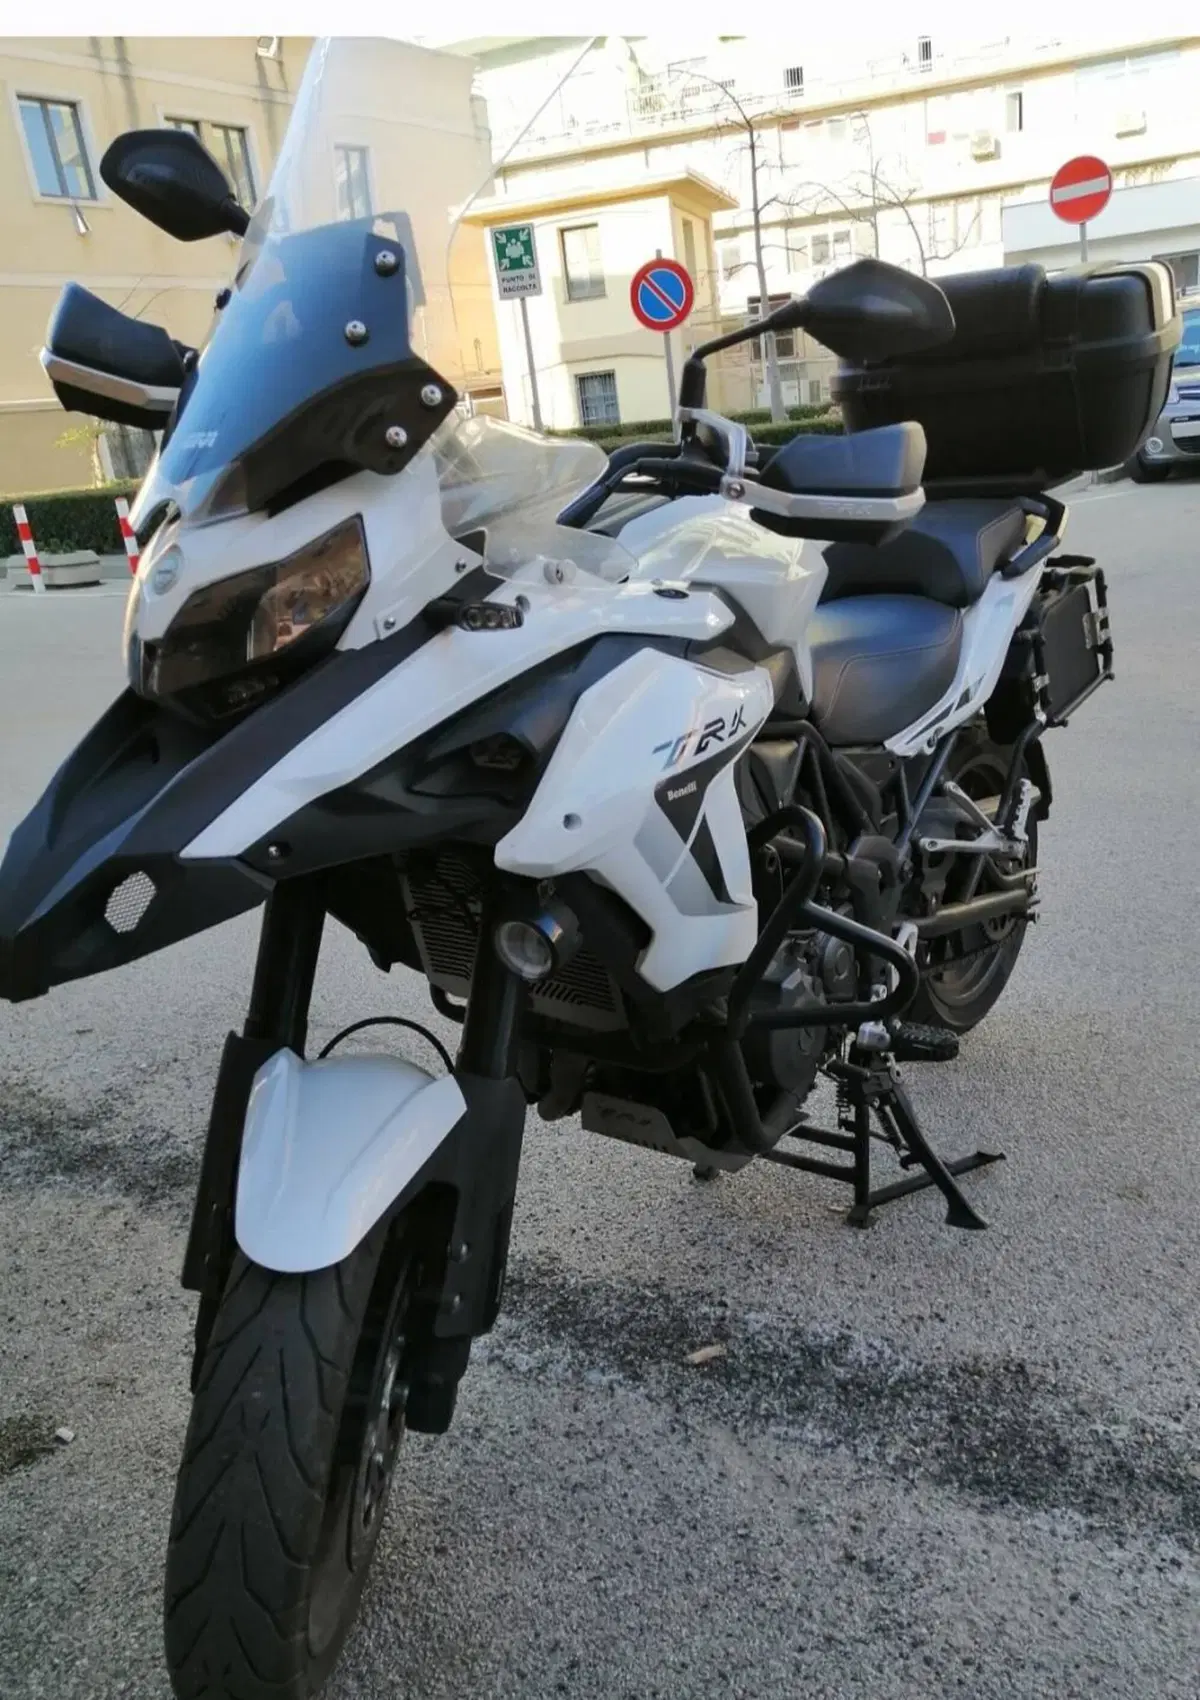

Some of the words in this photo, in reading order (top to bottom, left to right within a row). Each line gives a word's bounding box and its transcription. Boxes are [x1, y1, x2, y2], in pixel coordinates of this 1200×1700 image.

[501, 275, 524, 283] PUNTO
[528, 273, 536, 281] DI
[503, 283, 537, 293] RACCOLTA
[652, 704, 747, 770] TRK
[667, 780, 698, 802] Benelli
